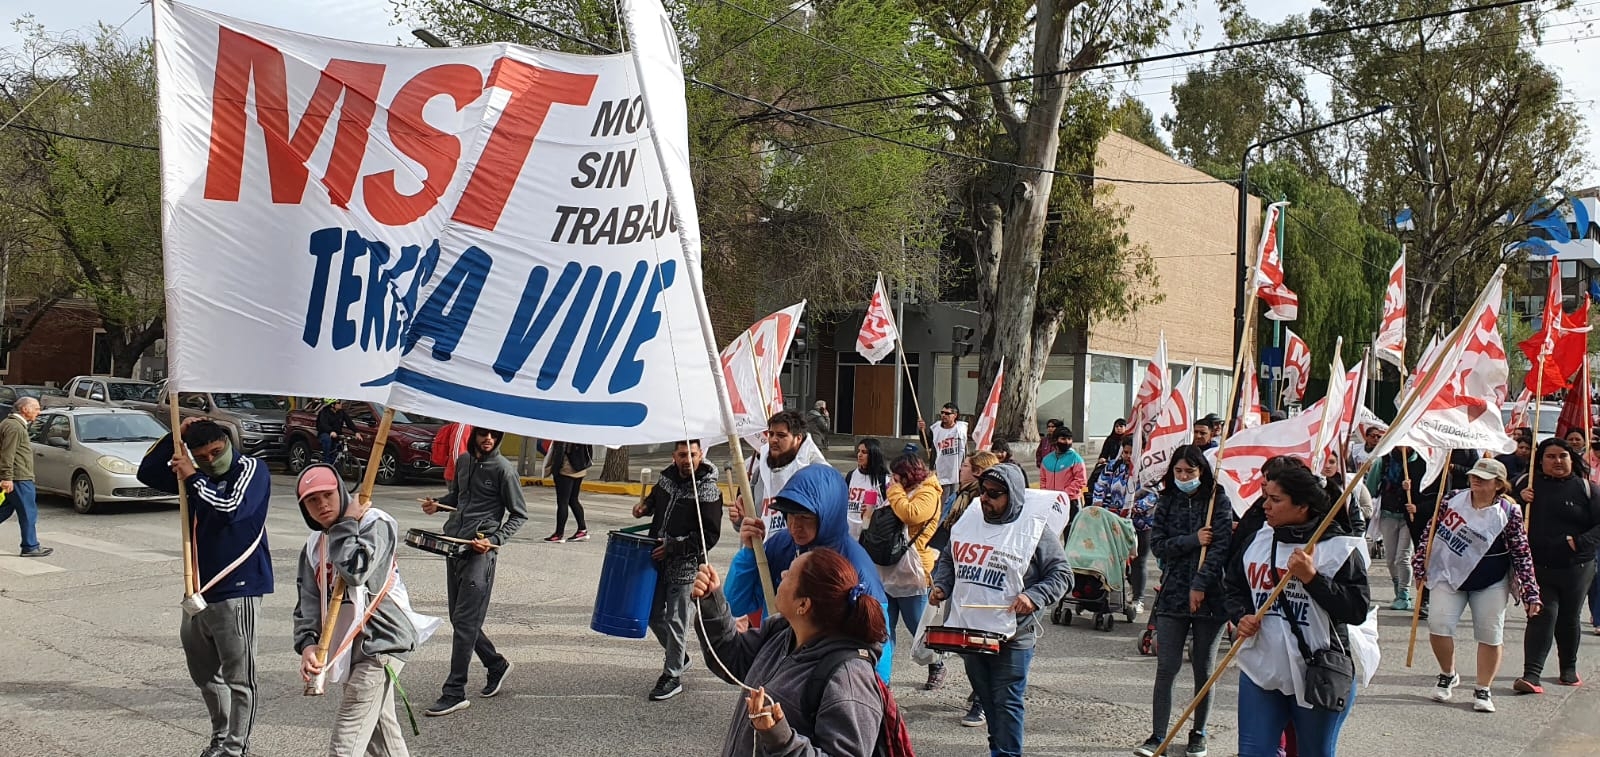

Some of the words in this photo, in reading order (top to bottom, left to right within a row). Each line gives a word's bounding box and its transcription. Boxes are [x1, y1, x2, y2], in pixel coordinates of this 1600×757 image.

[204, 25, 599, 232] MST
[590, 94, 649, 137] MO
[571, 148, 637, 189] SIN
[491, 259, 676, 395] VIVE
[953, 540, 994, 566] MST
[1449, 535, 1469, 554] VIVE
[982, 568, 1007, 588] VIVE
[1286, 582, 1297, 590] SIN
